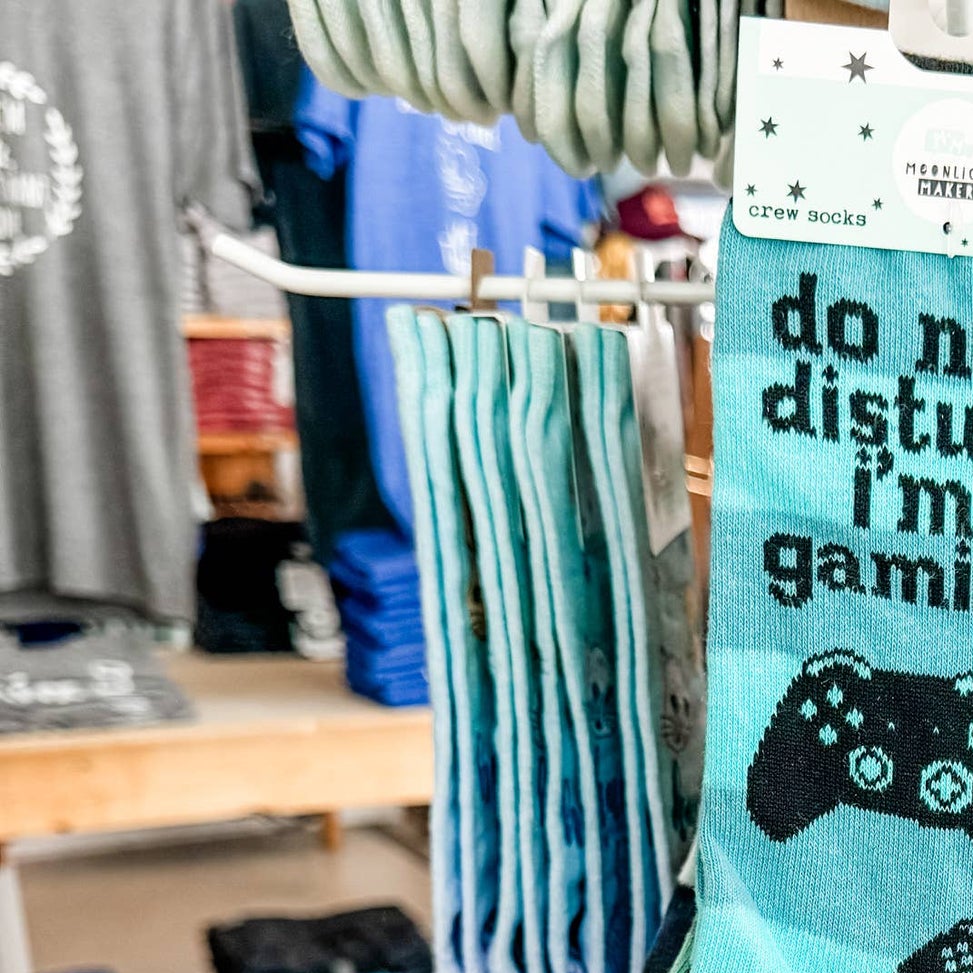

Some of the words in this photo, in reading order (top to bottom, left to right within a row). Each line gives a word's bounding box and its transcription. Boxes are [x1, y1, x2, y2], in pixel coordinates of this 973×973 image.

[748, 203, 799, 221] crew
[807, 208, 867, 227] socks
[771, 271, 879, 365] do
